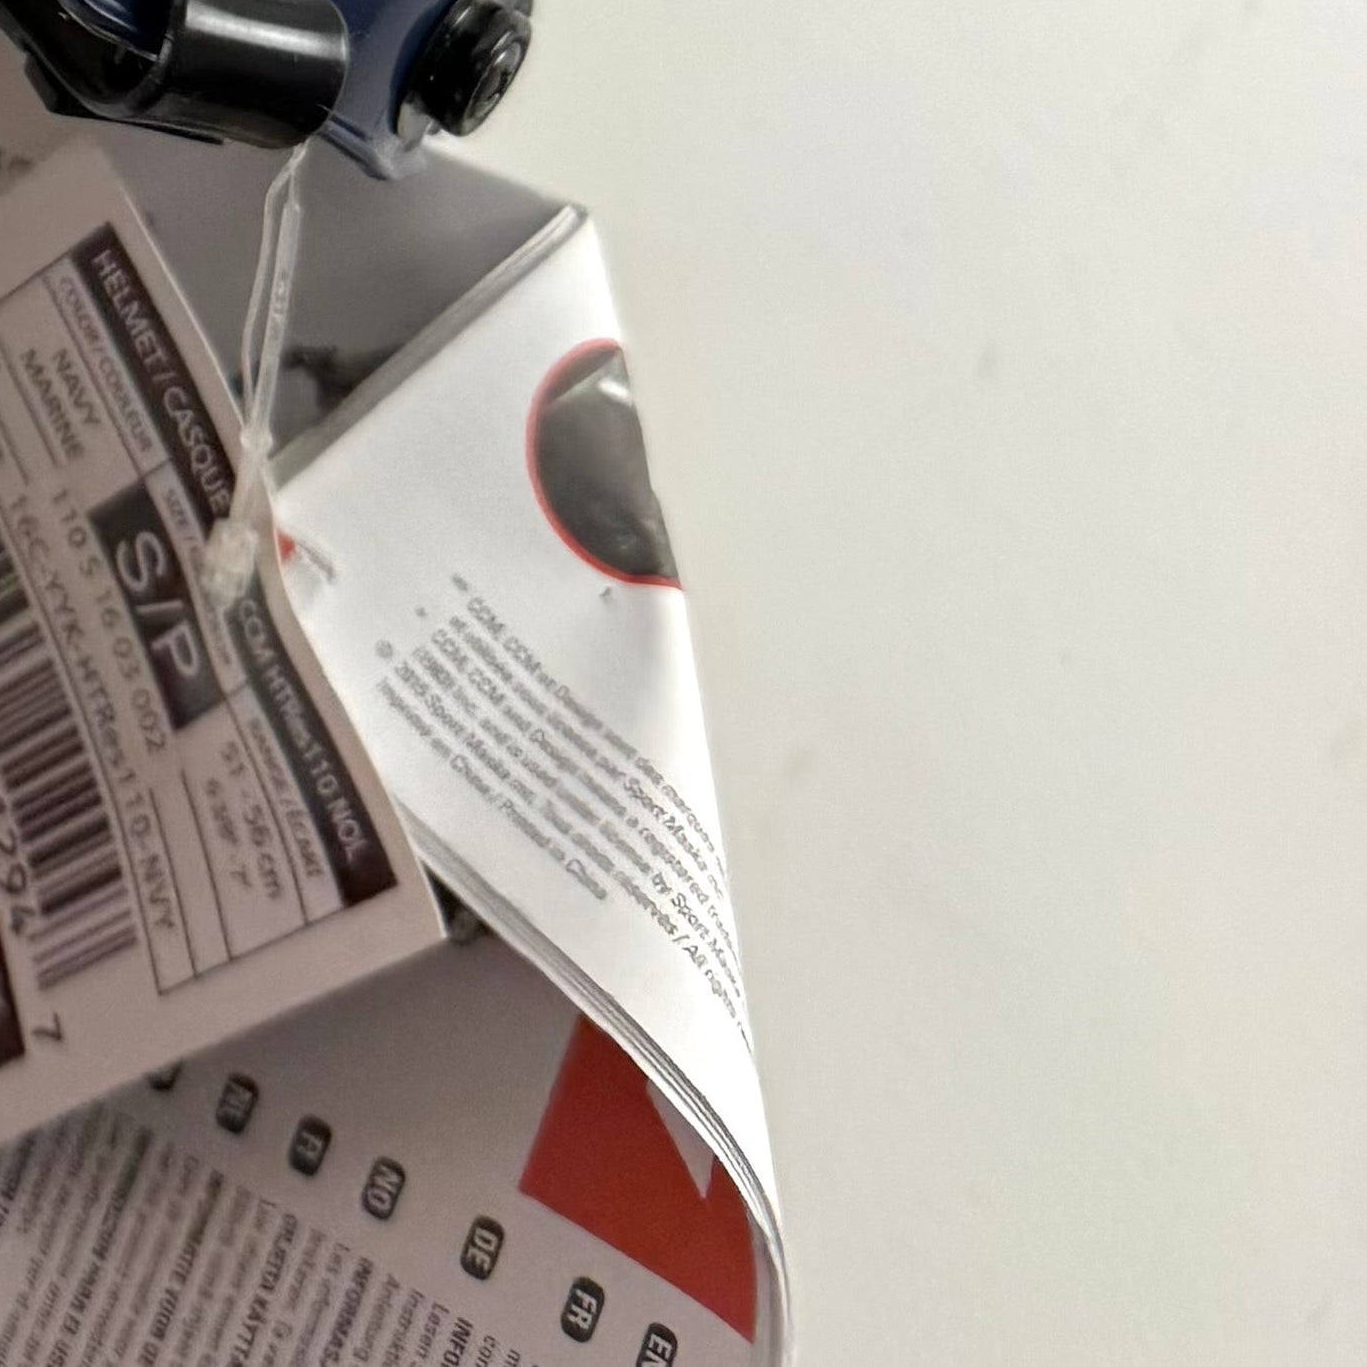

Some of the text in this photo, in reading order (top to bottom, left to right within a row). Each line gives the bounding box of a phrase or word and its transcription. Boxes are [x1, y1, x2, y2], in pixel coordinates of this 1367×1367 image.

[17, 347, 88, 464] MARINE
[49, 346, 104, 429] NAVY
[88, 247, 168, 371] HELMET
[156, 380, 239, 517] CASQUE
[106, 525, 202, 680] S/P
[25, 1012, 68, 1052] 7
[463, 1226, 499, 1272] DE
[565, 1287, 602, 1331] FR
